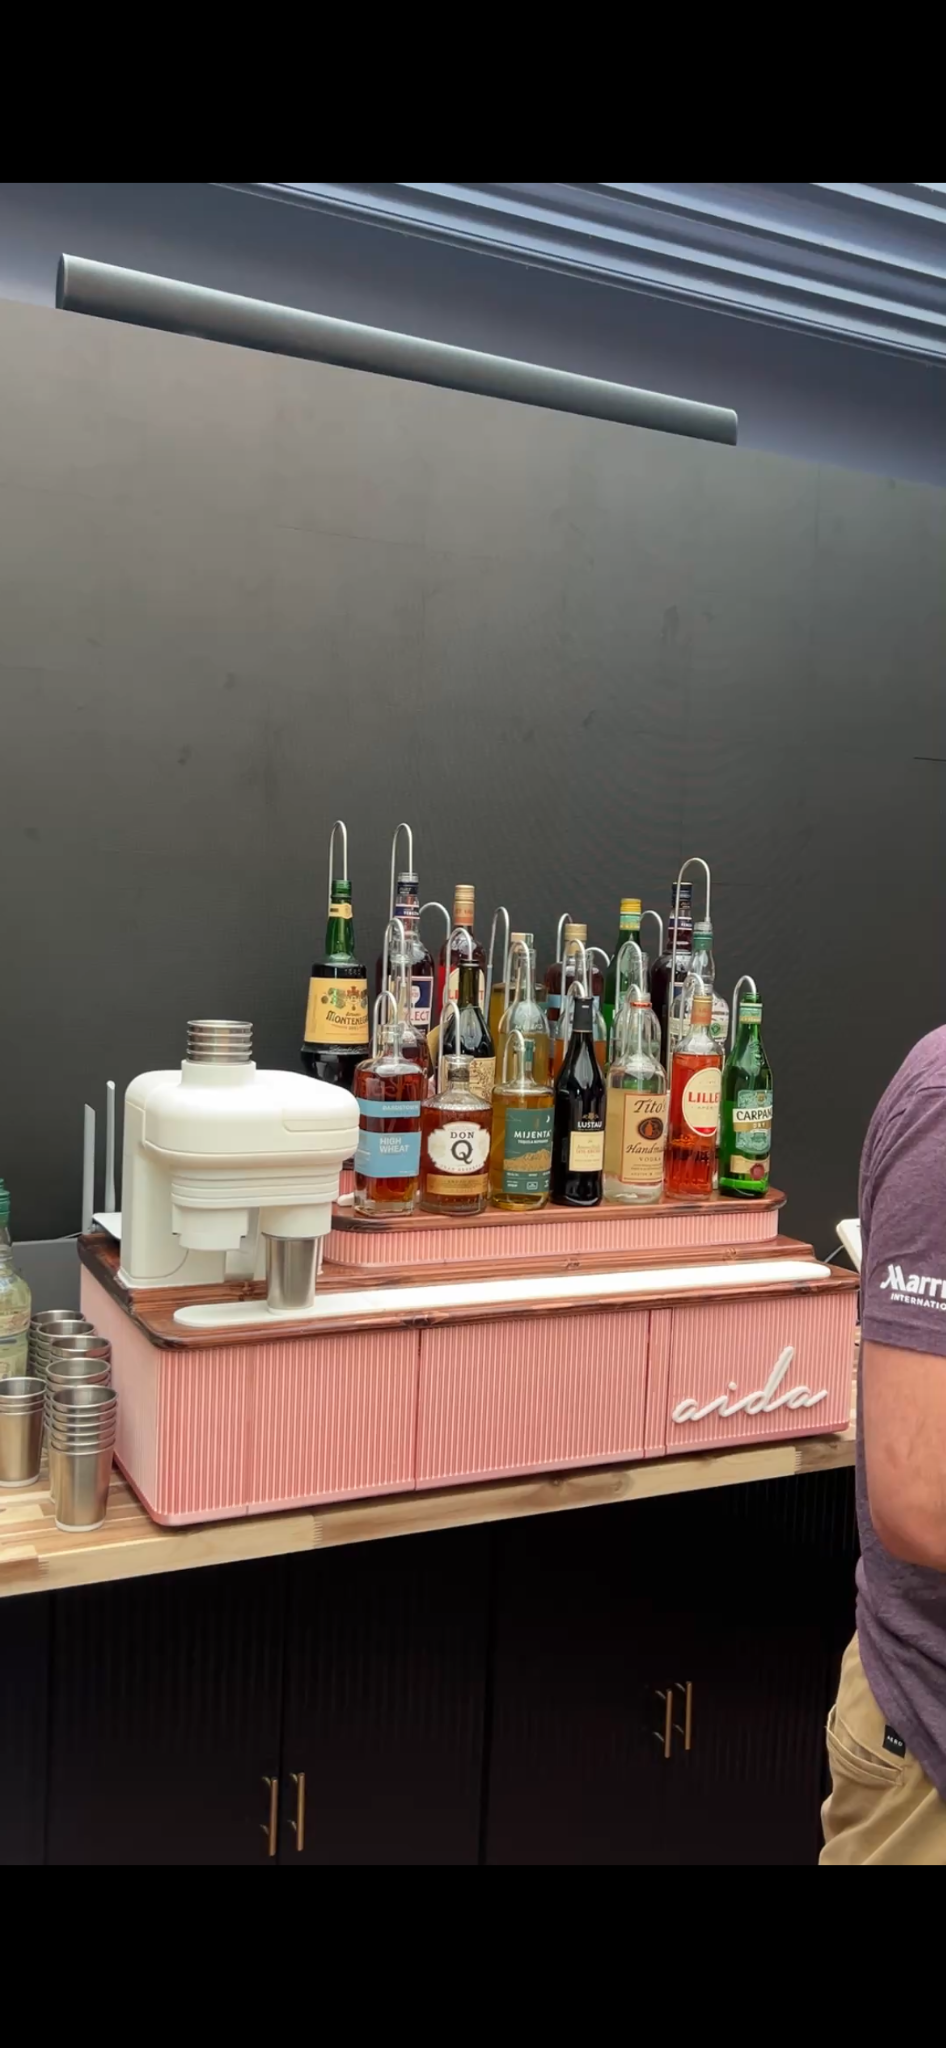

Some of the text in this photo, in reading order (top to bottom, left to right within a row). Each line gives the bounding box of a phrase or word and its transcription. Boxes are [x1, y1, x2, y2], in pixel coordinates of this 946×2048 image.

[450, 1131, 474, 1139] DON
[379, 1145, 410, 1153] WHEAT
[450, 1140, 473, 1165] Q
[672, 1346, 828, 1424] aida
